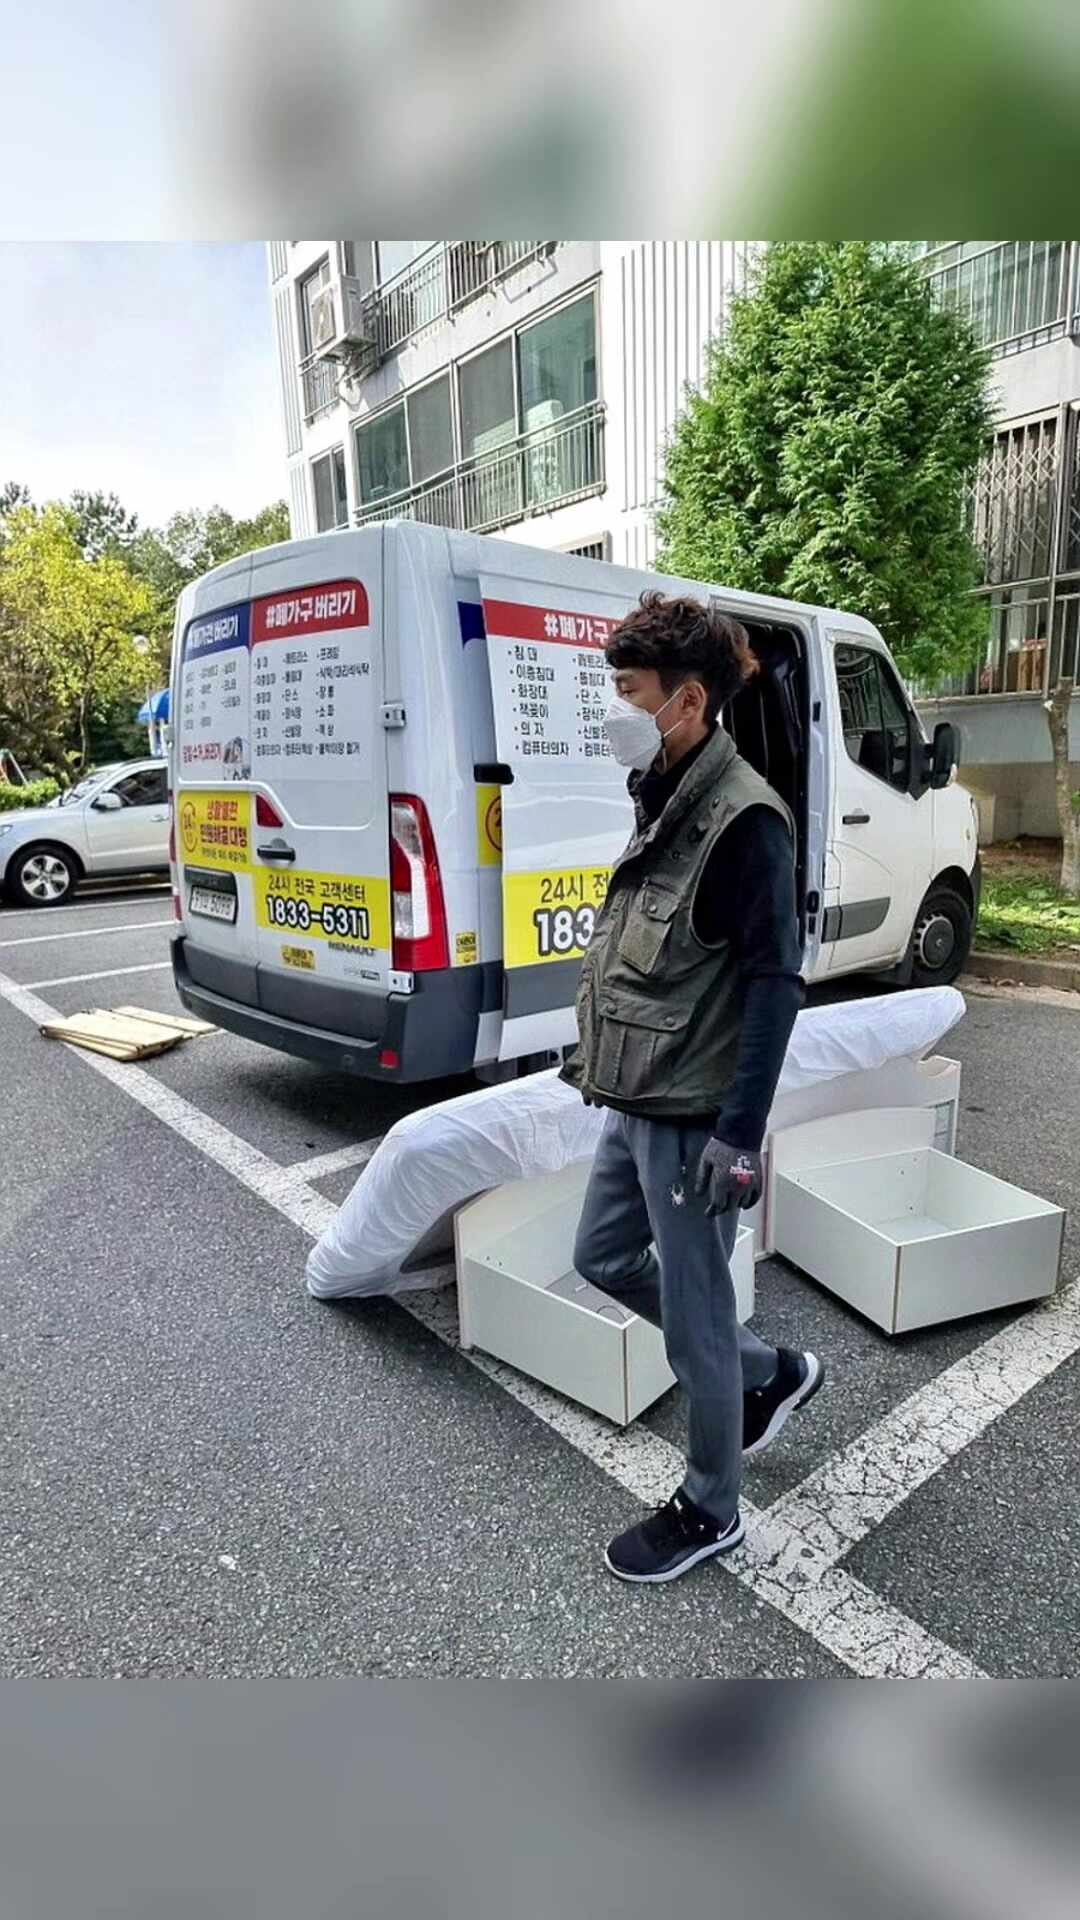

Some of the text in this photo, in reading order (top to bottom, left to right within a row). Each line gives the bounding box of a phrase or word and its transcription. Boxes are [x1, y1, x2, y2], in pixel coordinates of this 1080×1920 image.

[522, 740, 569, 757] 컴퓨터의자
[296, 877, 315, 896] 전국
[320, 880, 366, 904] 고객센터
[540, 872, 584, 904] 24시
[266, 894, 370, 940] 1833-5311
